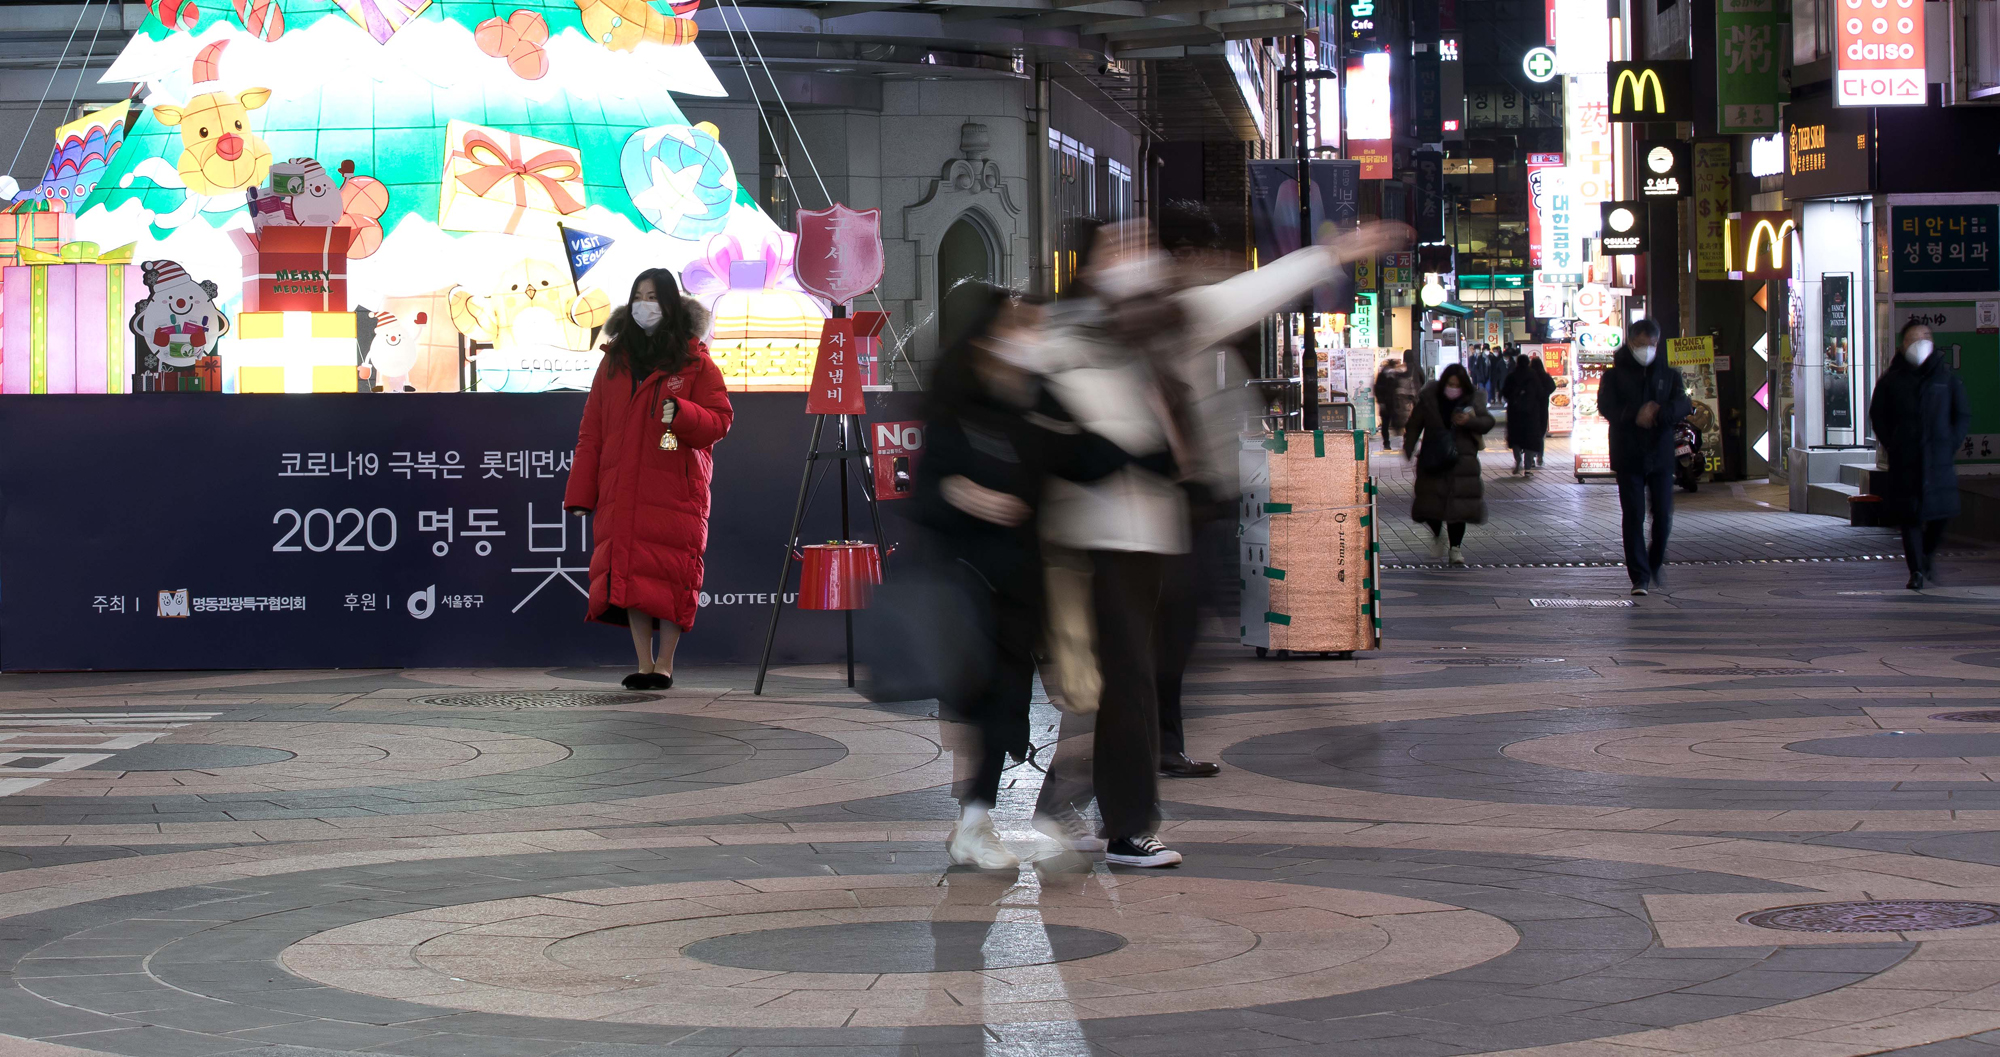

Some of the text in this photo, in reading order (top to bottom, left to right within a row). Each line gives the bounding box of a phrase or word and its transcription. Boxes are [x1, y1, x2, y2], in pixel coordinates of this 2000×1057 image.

[1352, 20, 1374, 30] Cafe
[1847, 39, 1914, 60] daiso
[1843, 78, 1920, 96] 다이소
[1798, 124, 1825, 151] TIGER SUGAR
[1902, 216, 1967, 236] 티안나
[572, 236, 600, 251] VISIT
[1604, 237, 1640, 245] OSULLOC
[575, 248, 607, 267] SEOUL
[824, 218, 851, 291] 구세군
[1904, 242, 1989, 264] 성형외과
[276, 269, 331, 282] MERRY
[273, 285, 334, 294] MEDIHEAL
[1579, 291, 1606, 318] 약
[1674, 337, 1705, 346] MONEY
[1545, 352, 1559, 360] 점심
[827, 332, 847, 403] 자선냄비
[278, 451, 379, 480] 코로나19
[388, 451, 465, 480] 극복은
[1704, 457, 1720, 471] 5F
[272, 508, 397, 552] 2020
[418, 508, 506, 557] 명동
[1334, 513, 1347, 566] Smart-Q
[92, 595, 125, 614] 주최
[193, 596, 306, 611] 명동관광특구협의회
[344, 593, 376, 611] 후원
[441, 594, 484, 608] 서울중구
[715, 593, 767, 605] LOTTE
